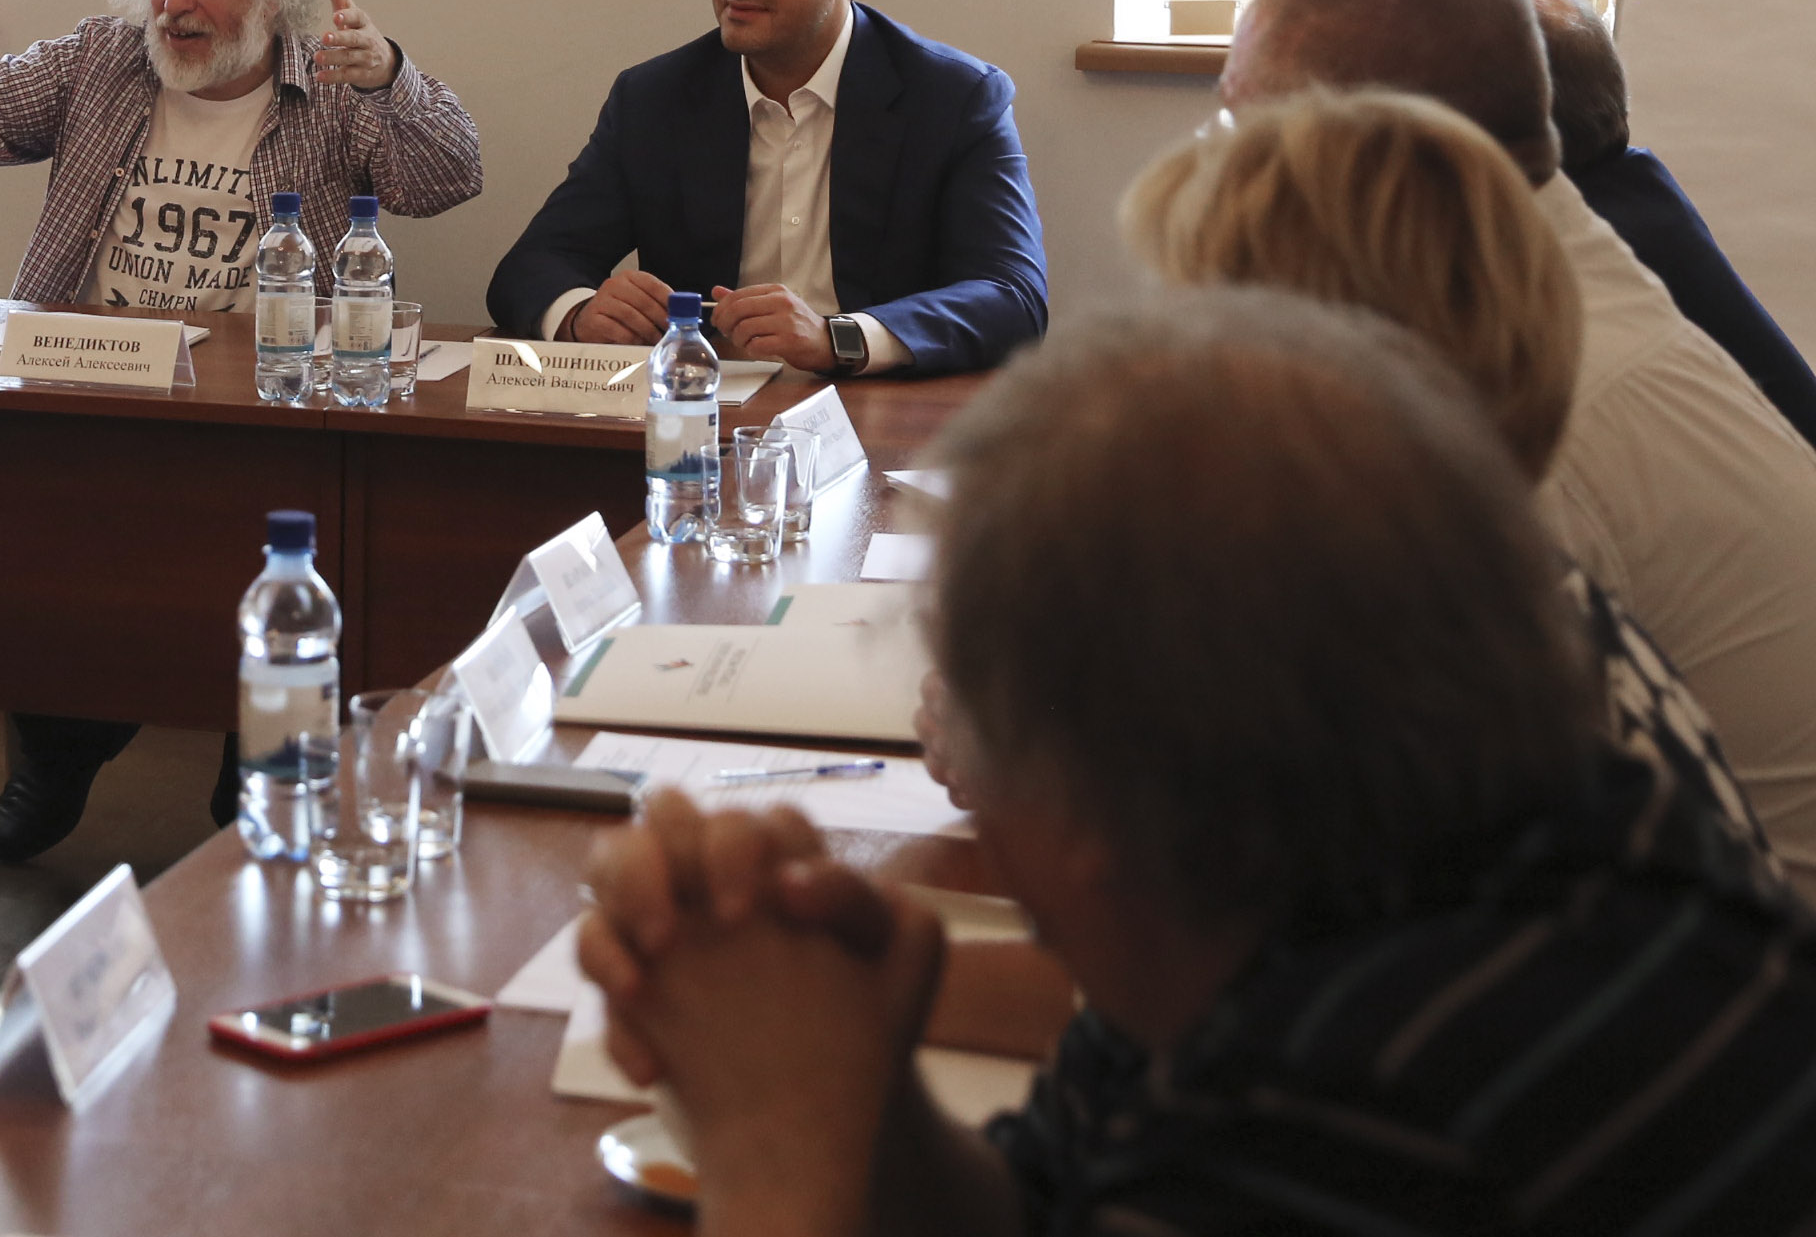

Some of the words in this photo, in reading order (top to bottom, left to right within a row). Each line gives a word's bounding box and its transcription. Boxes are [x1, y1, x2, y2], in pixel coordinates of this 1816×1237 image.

[122, 196, 257, 264] 1967
[108, 245, 175, 284] UNION
[184, 264, 253, 290] MADE
[138, 288, 198, 312] CHMPN
[33, 335, 141, 353] ВЕНЕДИКТОВ
[16, 353, 71, 369] Алексей
[73, 356, 151, 373] Алексеевич
[495, 353, 634, 372] ШАОШНИКО
[486, 372, 546, 387] Алексей
[551, 375, 634, 393] Валерьевич
